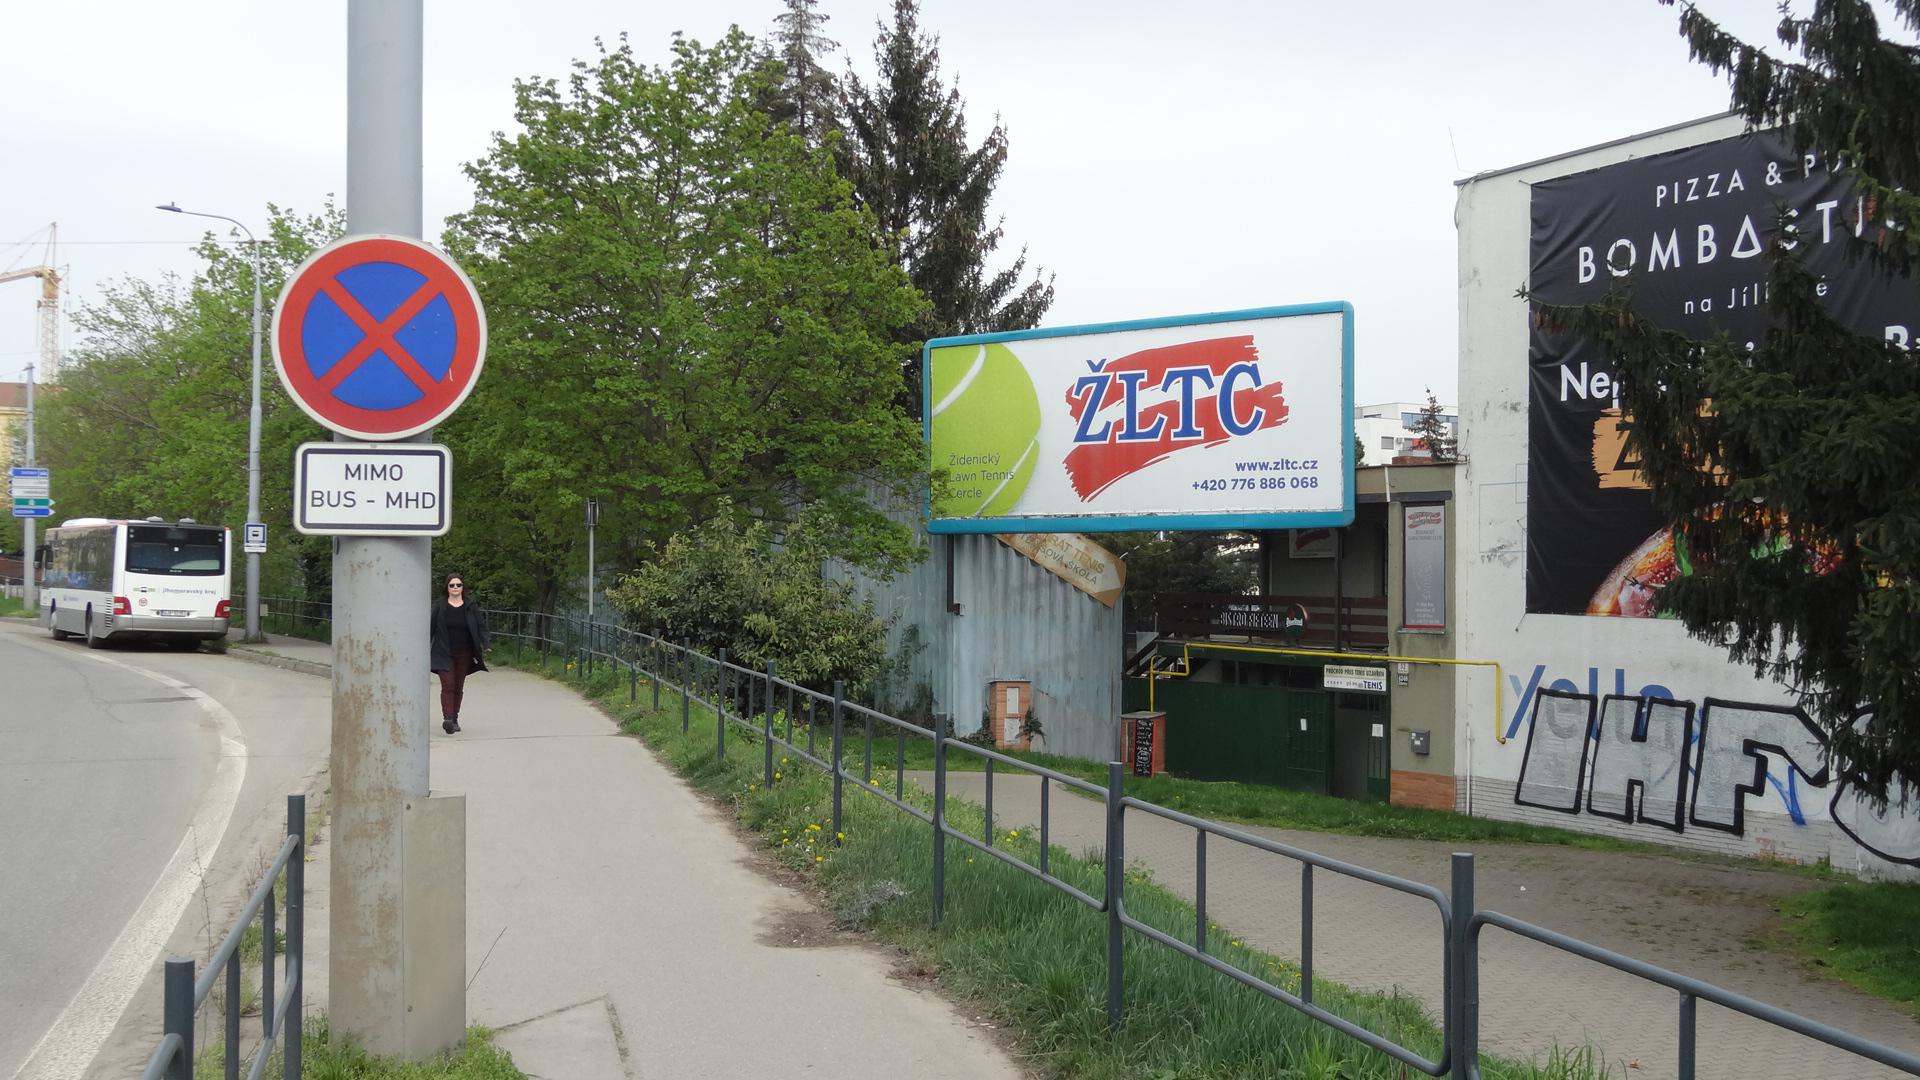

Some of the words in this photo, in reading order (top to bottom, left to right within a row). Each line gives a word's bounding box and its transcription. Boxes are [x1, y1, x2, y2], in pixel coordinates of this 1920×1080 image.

[1655, 168, 1745, 208] PIZZA
[1764, 161, 1783, 186] &
[1684, 298, 1712, 314] na
[1073, 358, 1263, 443] ŽLTC
[949, 453, 1001, 466] Židenický
[1235, 458, 1318, 472] www.zltc.cz
[344, 463, 404, 481] MIMO
[980, 468, 1015, 481] Tennis
[1192, 479, 1227, 491] +420
[1231, 478, 1256, 490] 776
[1259, 477, 1286, 490] 886
[1290, 476, 1319, 489] 068
[311, 490, 357, 508] BUS
[385, 491, 436, 509] MHD
[1363, 680, 1383, 690] TENIS
